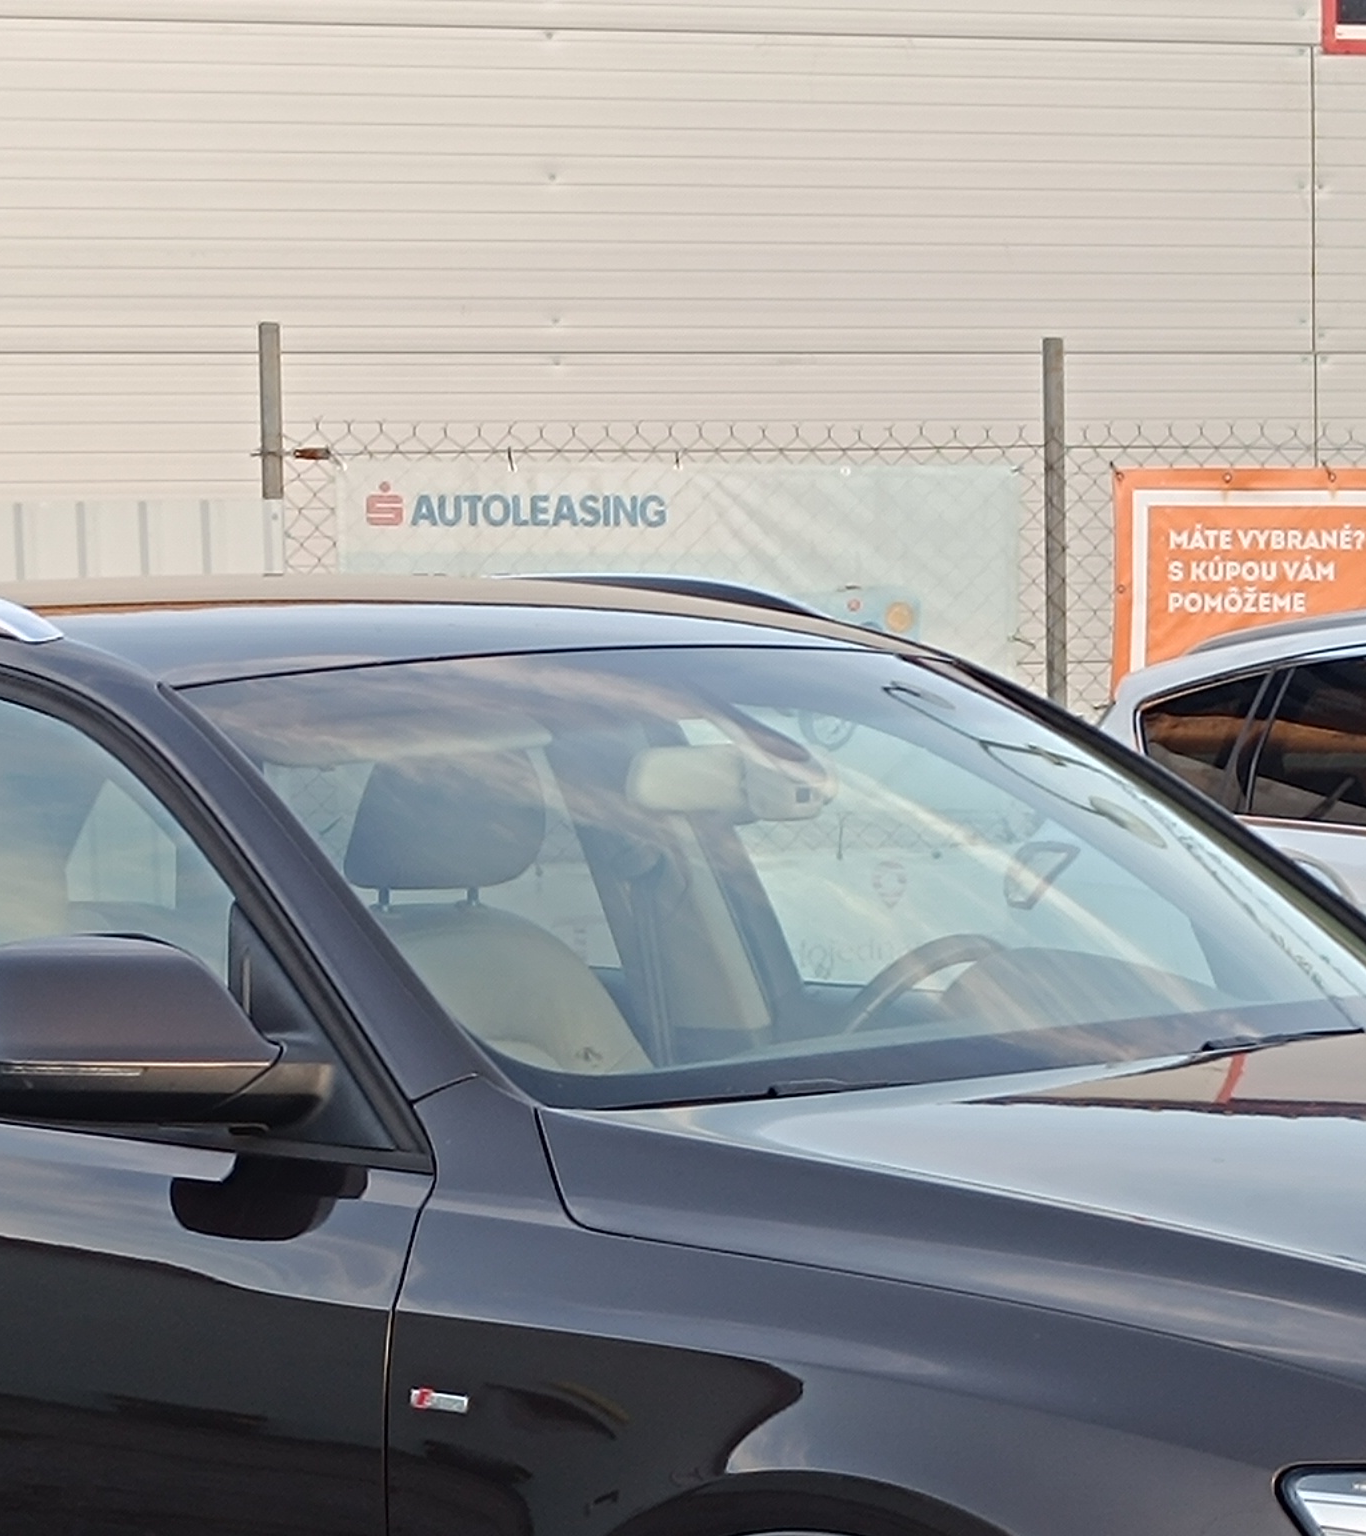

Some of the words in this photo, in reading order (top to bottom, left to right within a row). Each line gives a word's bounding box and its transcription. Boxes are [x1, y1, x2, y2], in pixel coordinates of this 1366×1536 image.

[410, 494, 667, 528] AUTOLEASING
[1168, 523, 1233, 550] MÁTE
[1236, 523, 1366, 550] VYBRANÉ?
[1167, 560, 1184, 582] S
[1190, 555, 1277, 582] KÚPOU
[1282, 555, 1336, 582] VÁM
[1167, 586, 1307, 613] POMÔŽEME
